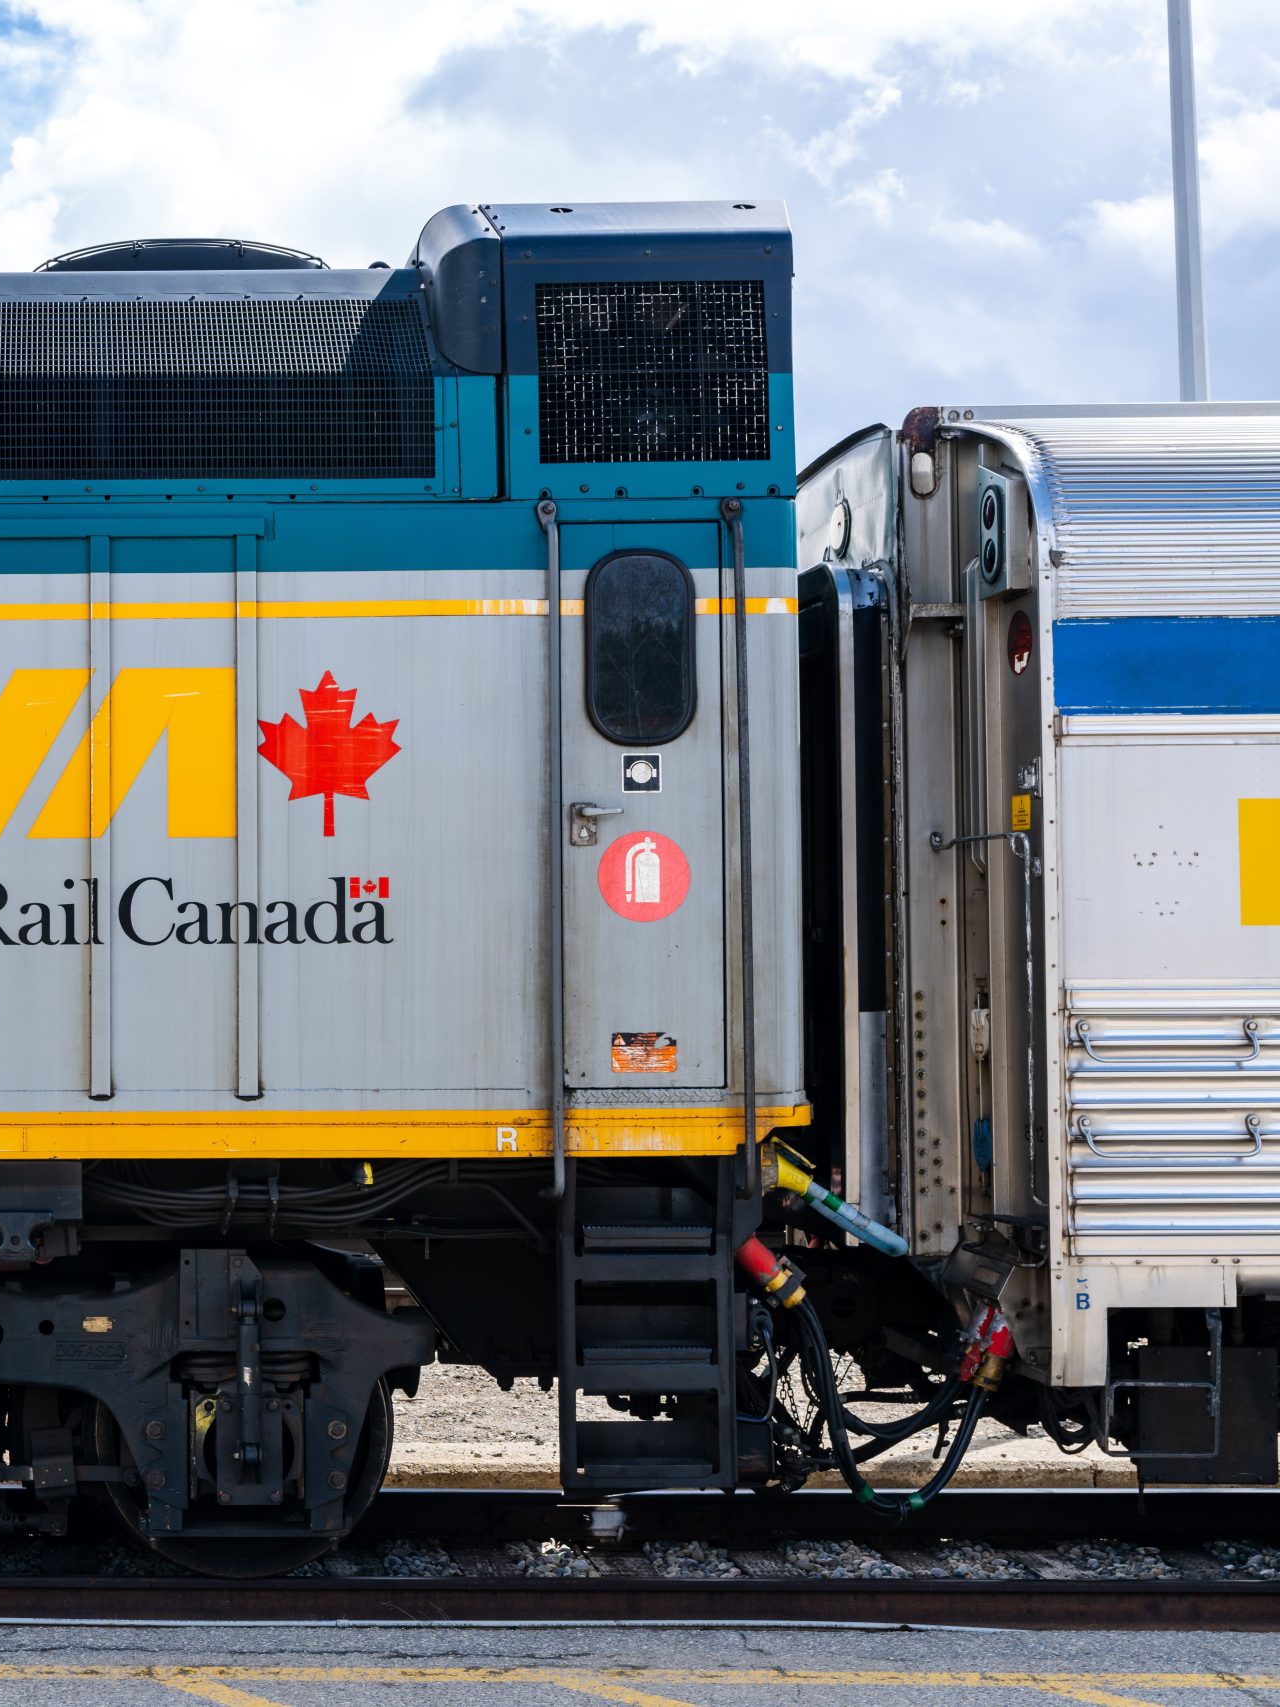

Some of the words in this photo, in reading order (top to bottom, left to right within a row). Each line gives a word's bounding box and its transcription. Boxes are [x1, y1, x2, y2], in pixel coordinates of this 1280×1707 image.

[118, 876, 394, 946] Canada
[496, 1127, 519, 1152] R
[1076, 1292, 1091, 1311] B
